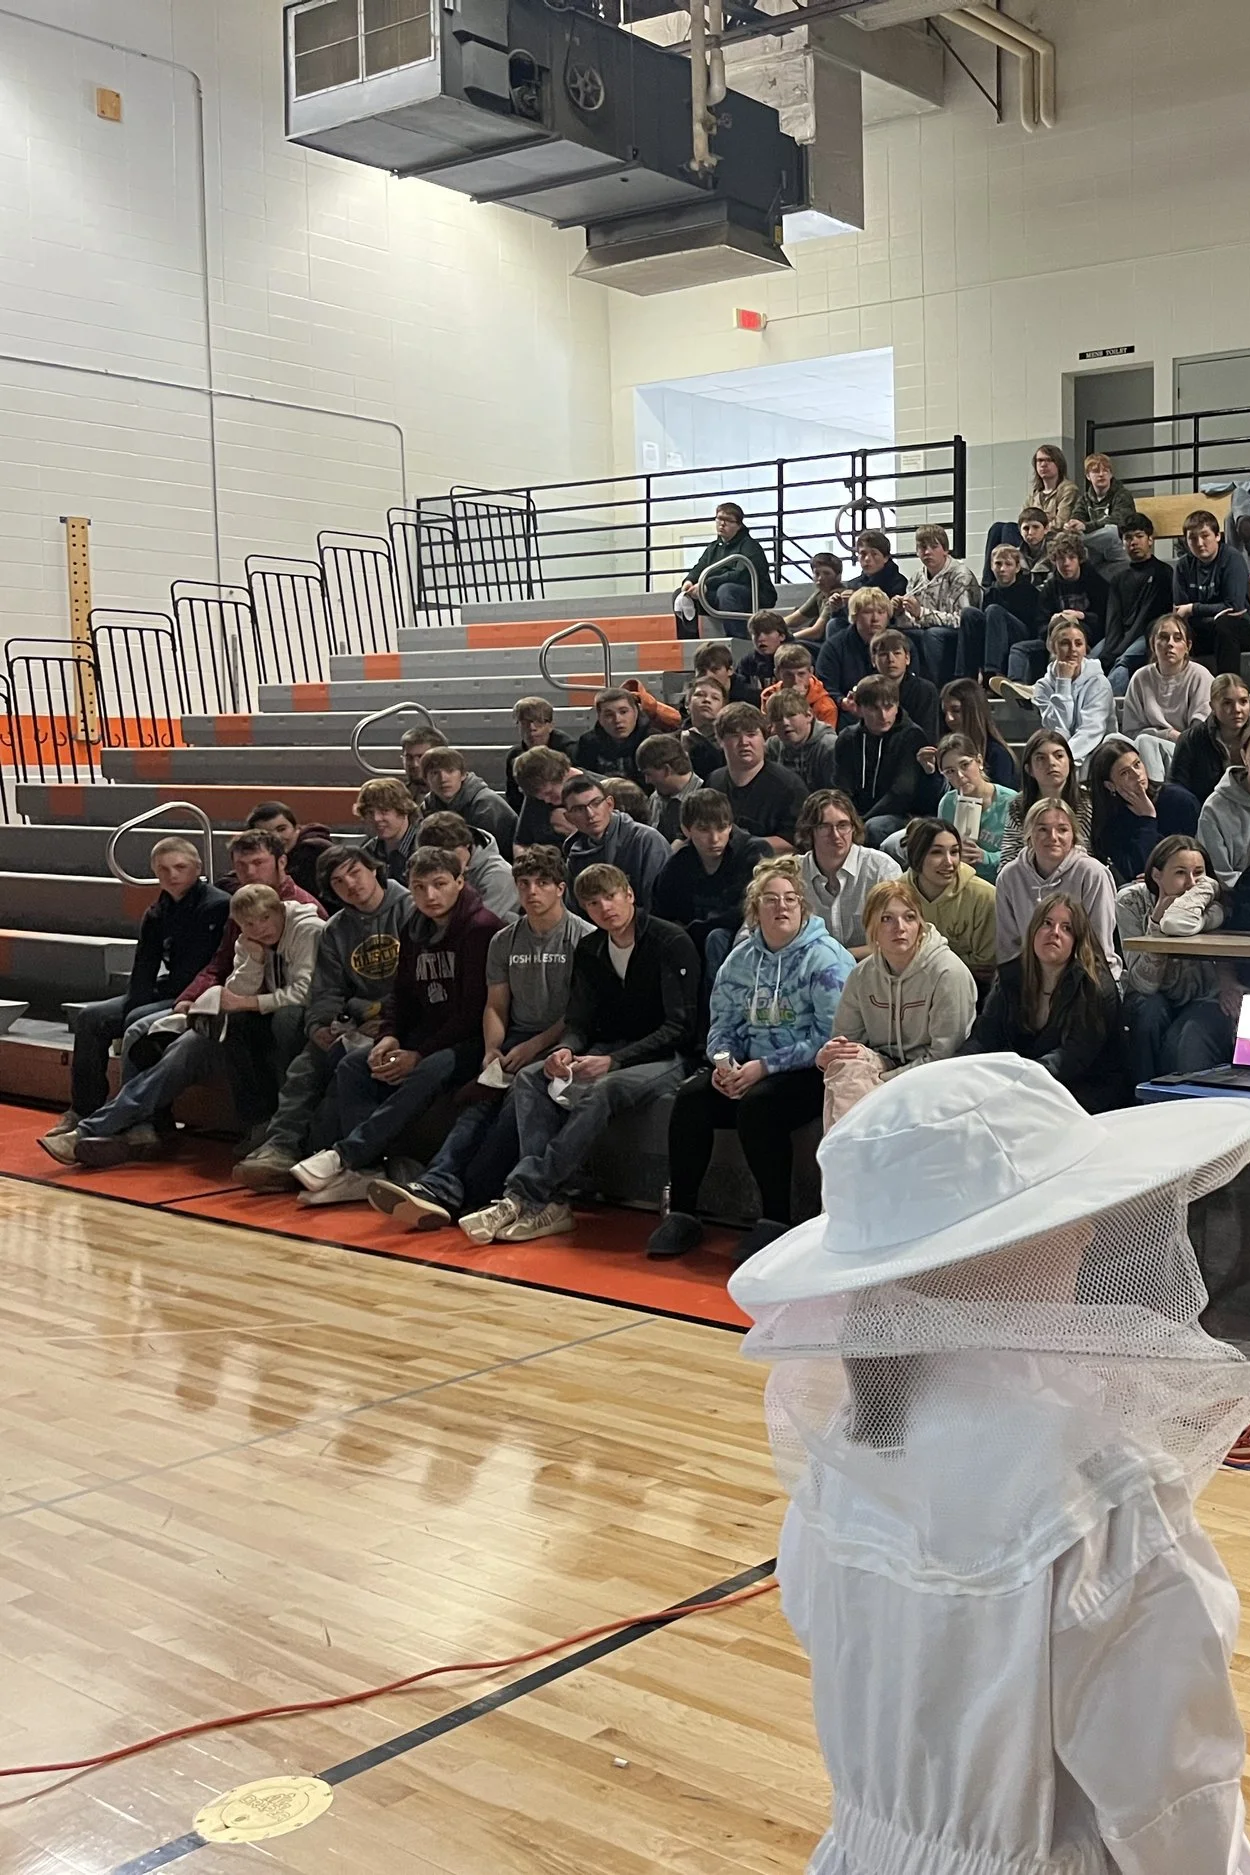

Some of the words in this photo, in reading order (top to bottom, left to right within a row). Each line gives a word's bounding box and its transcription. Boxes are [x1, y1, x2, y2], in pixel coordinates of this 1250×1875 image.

[1085, 350, 1104, 359] MENS
[1105, 347, 1128, 356] TOILET
[509, 954, 532, 966] JOSH
